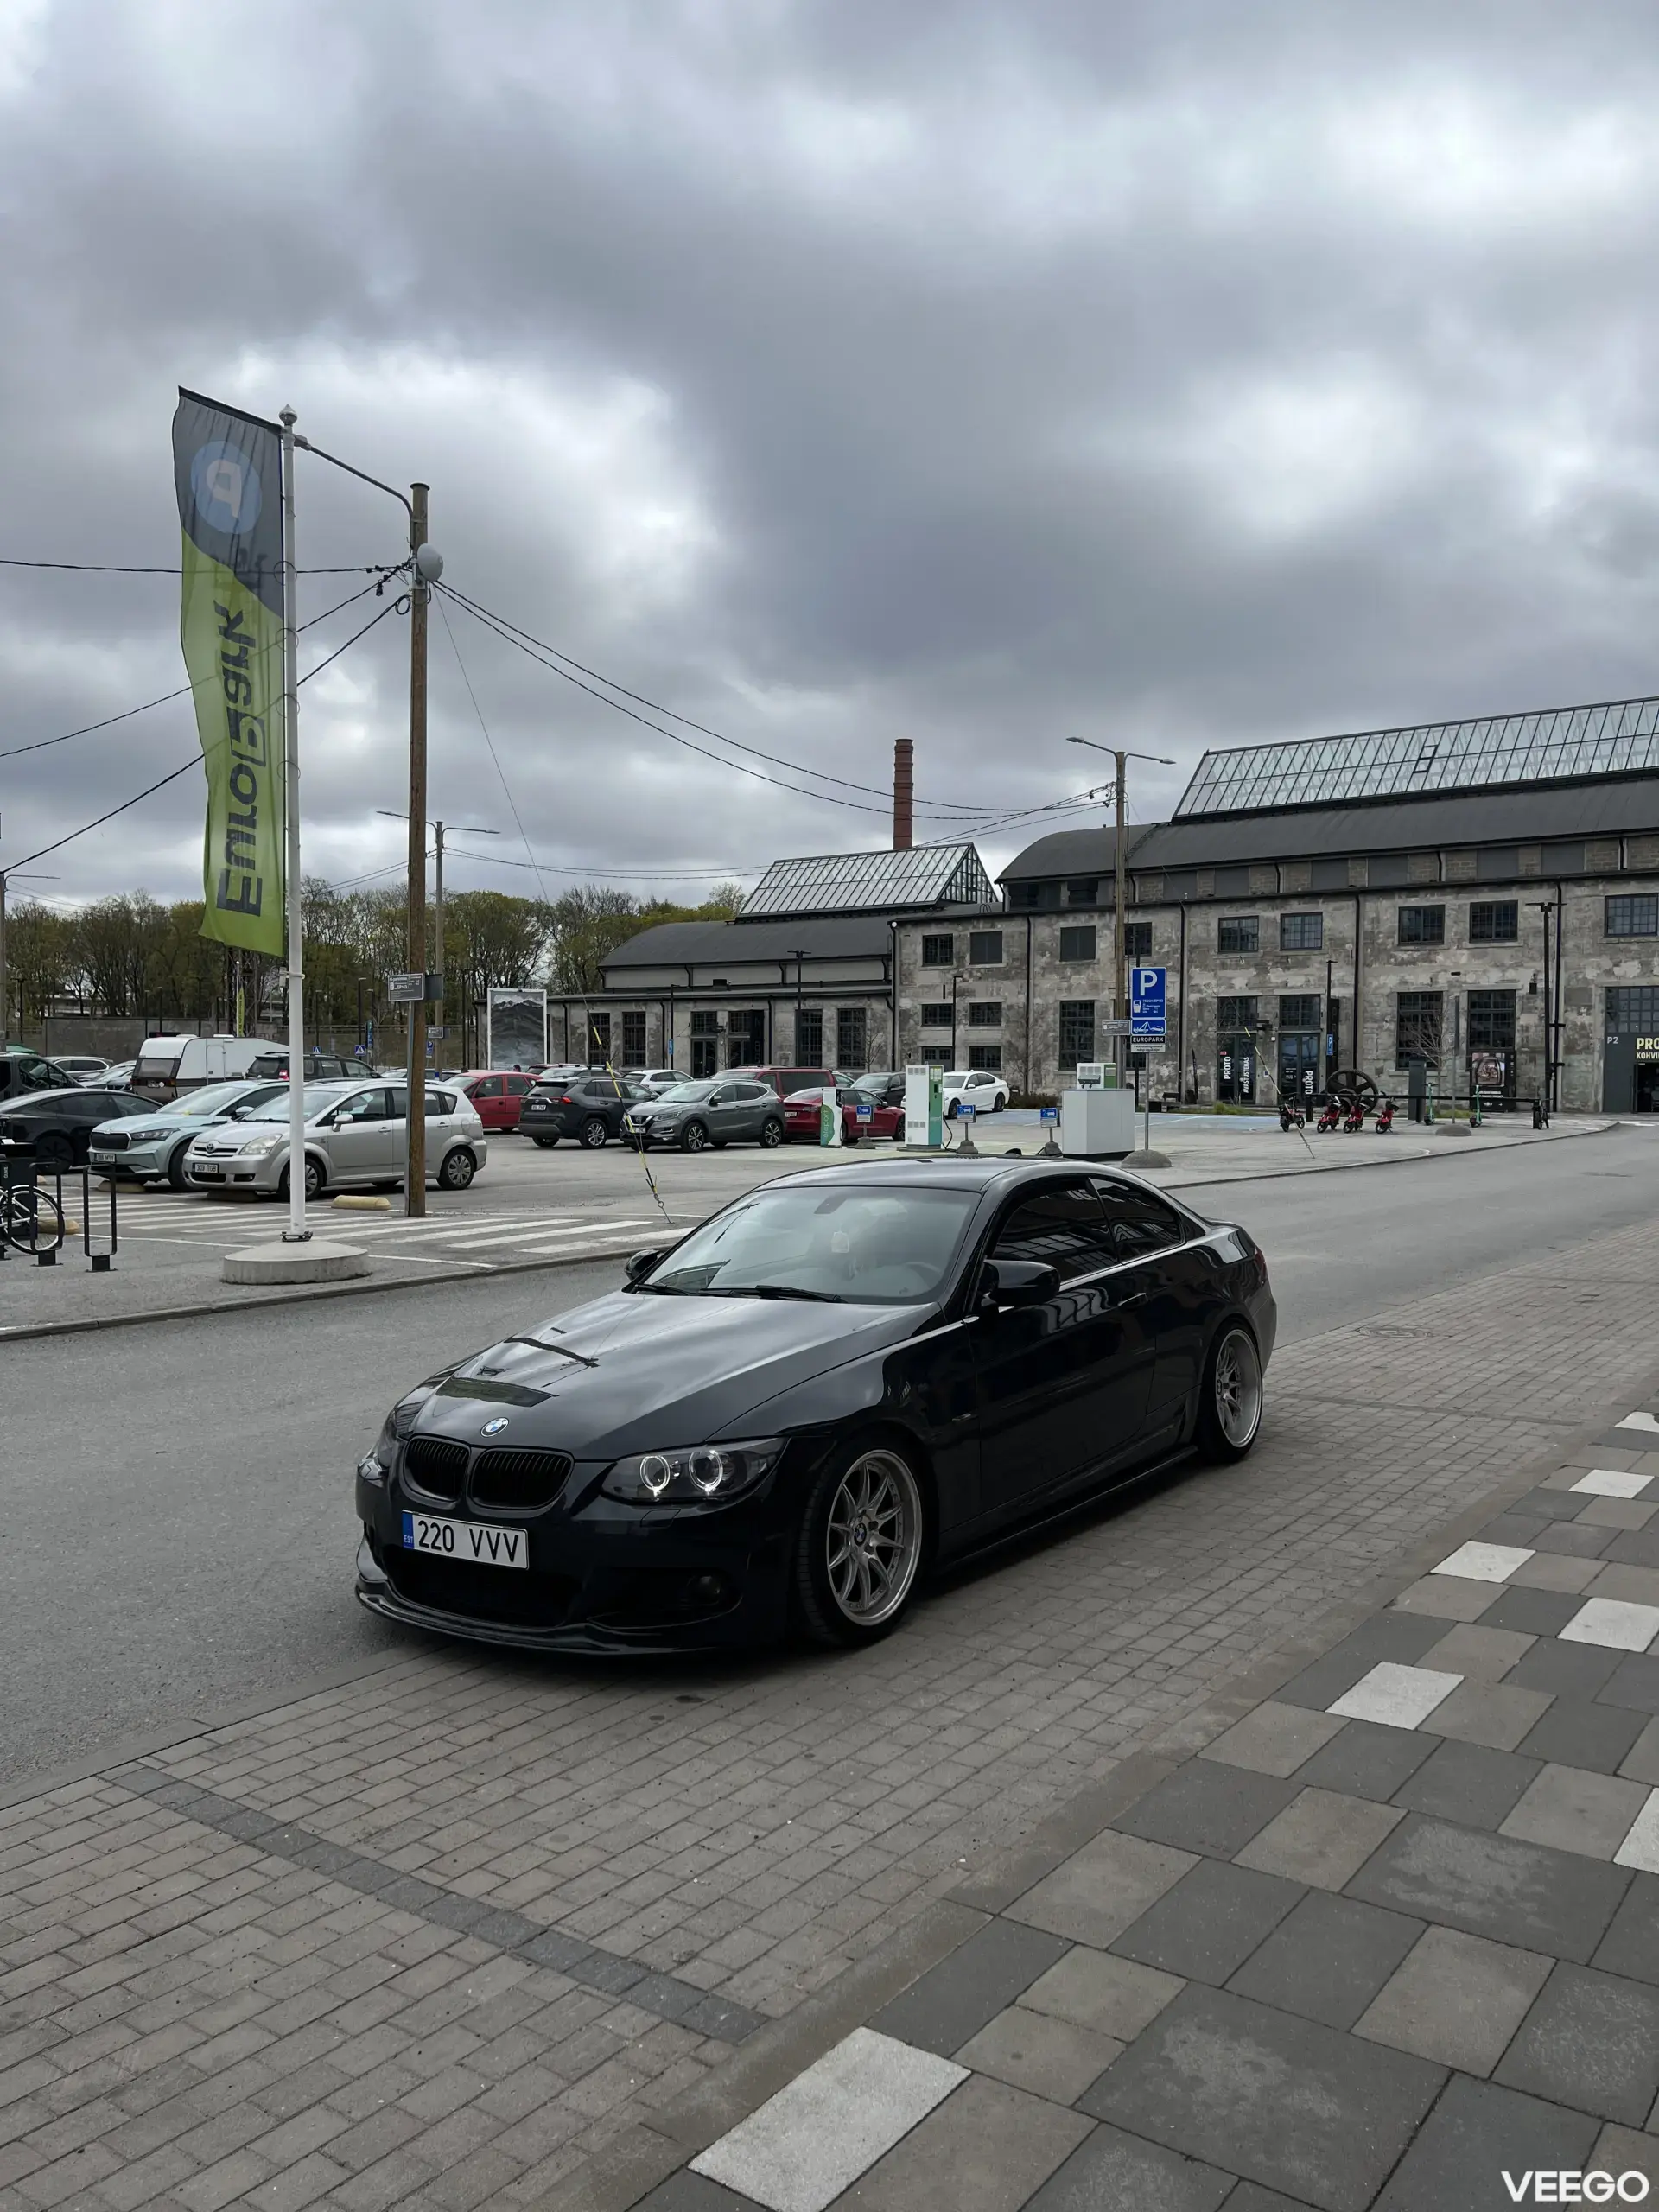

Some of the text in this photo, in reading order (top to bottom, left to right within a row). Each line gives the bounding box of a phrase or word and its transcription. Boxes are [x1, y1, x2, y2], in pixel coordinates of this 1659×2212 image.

[1140, 970, 1158, 996] P
[1305, 1071, 1313, 1095] PROTO
[404, 1535, 414, 1543] EST
[417, 1520, 519, 1563] 220 VVV
